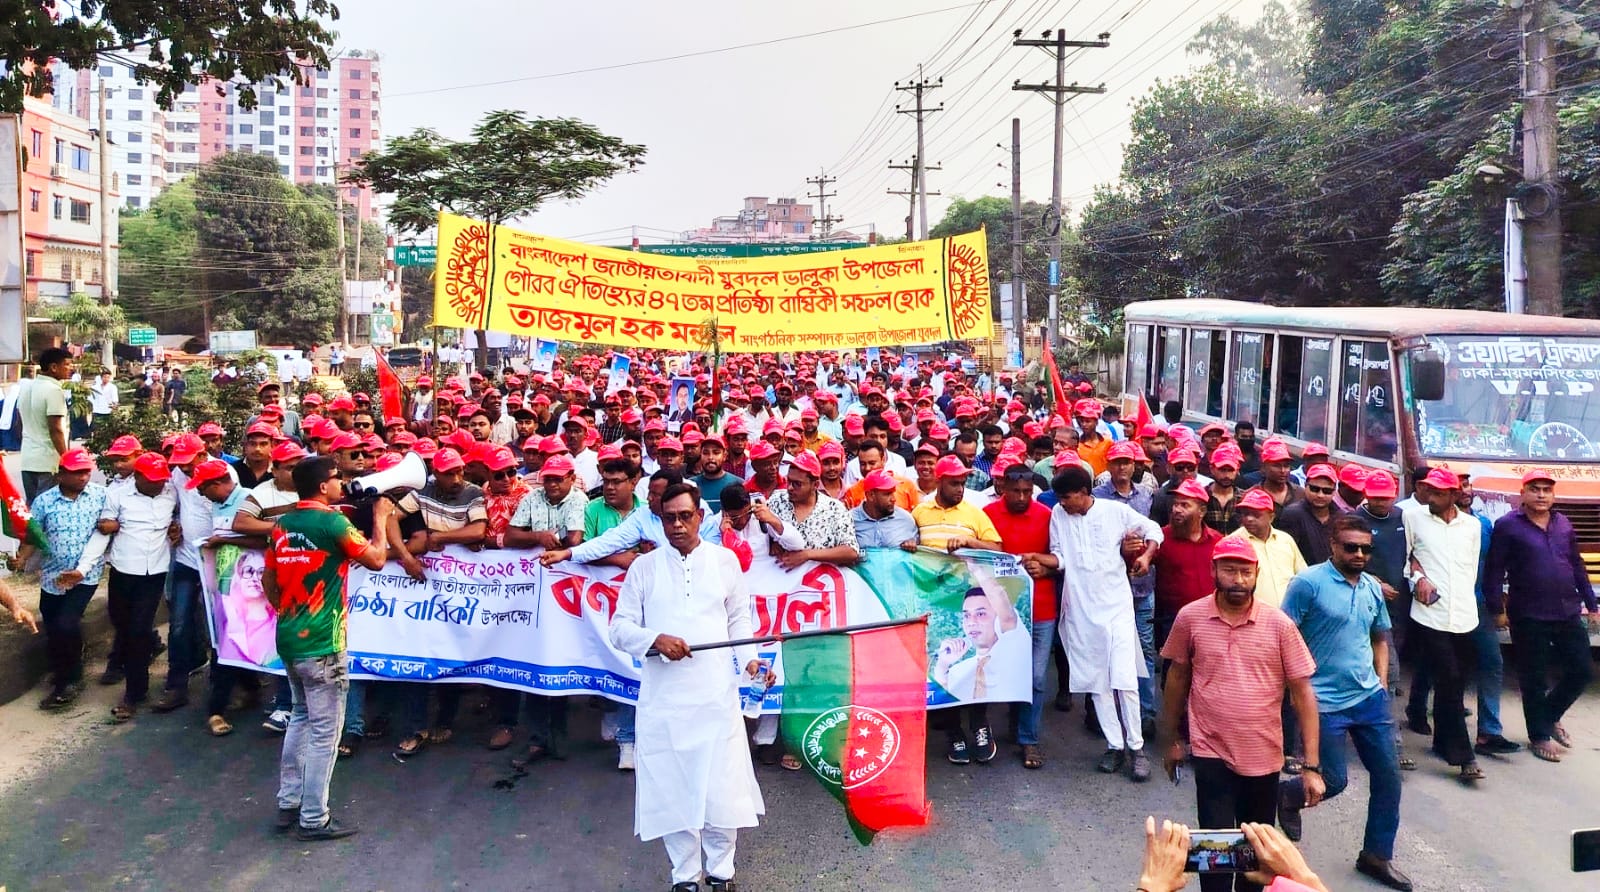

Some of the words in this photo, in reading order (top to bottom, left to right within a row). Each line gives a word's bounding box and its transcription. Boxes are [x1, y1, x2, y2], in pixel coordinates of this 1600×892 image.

[508, 243, 587, 272] বাংলাদেশ
[591, 257, 715, 286] জাতীয়তাবাদী
[717, 271, 779, 290] যুবদল
[782, 266, 839, 289] ভালুকা
[842, 257, 925, 281] উপজেলা
[504, 262, 555, 297] গৌরব
[716, 288, 774, 315] প্রতিষ্ঠা
[778, 286, 837, 315] বার্ষিকী
[840, 291, 891, 314] সফল
[892, 286, 935, 314] হোক
[507, 303, 616, 341] তাজমুল
[620, 316, 666, 343] হক
[740, 330, 795, 347] সাংগঠনিক
[798, 333, 844, 346] সম্পাদক
[847, 331, 878, 347] ভালুকা
[878, 325, 916, 343] উপজেলা
[916, 327, 942, 343] যুবদল
[479, 562, 516, 578] ২০২৫
[520, 557, 535, 577] ইং
[368, 572, 428, 591] বাংলাদেশ
[432, 576, 500, 597] জাতীয়তাবাদী
[504, 582, 535, 599] যুবদল
[403, 593, 479, 626] বার্ষিকী
[360, 656, 388, 673] হক
[538, 670, 593, 686] ময়মনসিংহ
